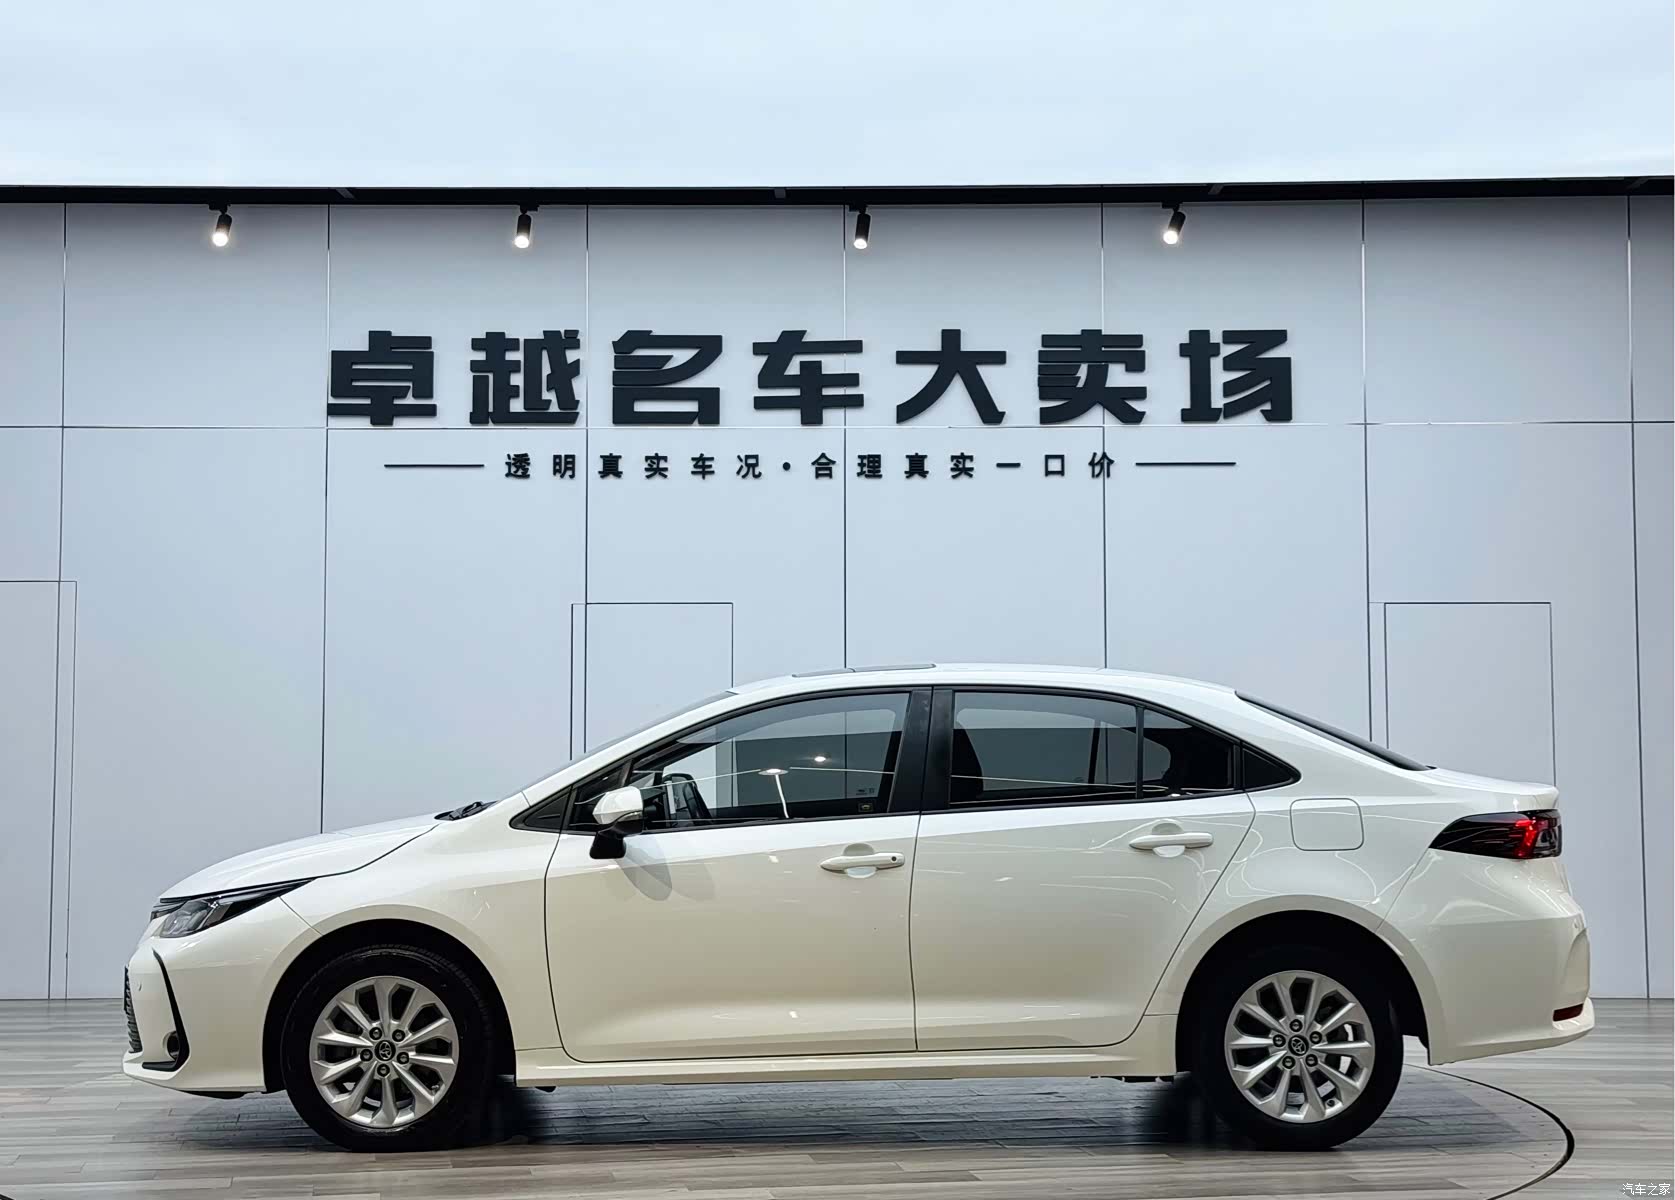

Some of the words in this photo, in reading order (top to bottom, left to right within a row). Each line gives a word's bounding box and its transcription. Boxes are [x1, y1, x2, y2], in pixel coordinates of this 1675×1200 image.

[327, 329, 1293, 426] 卓越名车大卖场
